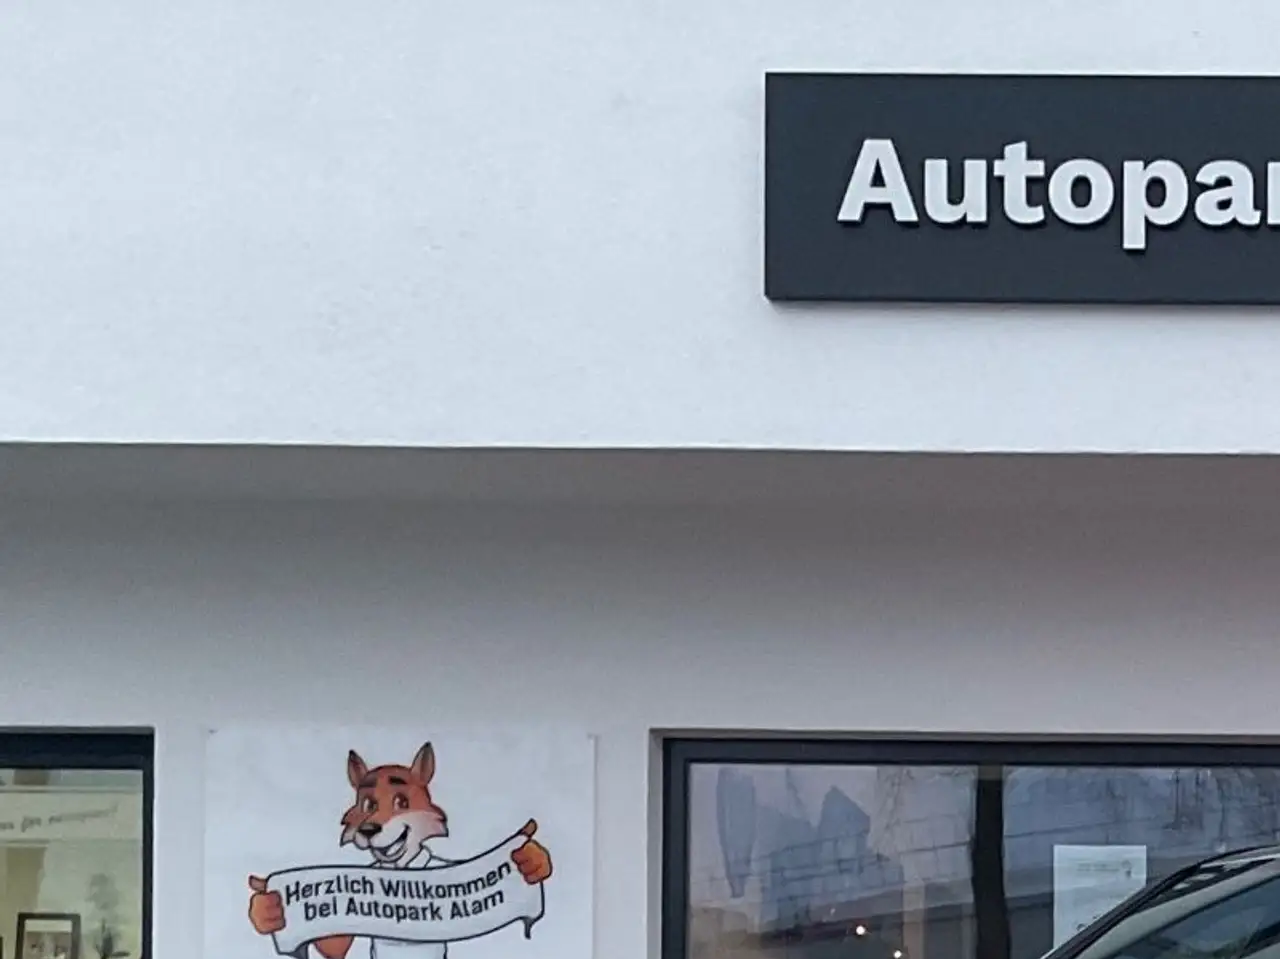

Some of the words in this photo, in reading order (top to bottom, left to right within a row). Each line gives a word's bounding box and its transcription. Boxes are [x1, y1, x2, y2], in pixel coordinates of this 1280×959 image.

[285, 874, 375, 906] Herzlich
[379, 861, 512, 900] Willkommen
[304, 896, 338, 921] bei
[345, 898, 443, 923] Autopark
[449, 889, 505, 921] Alam
